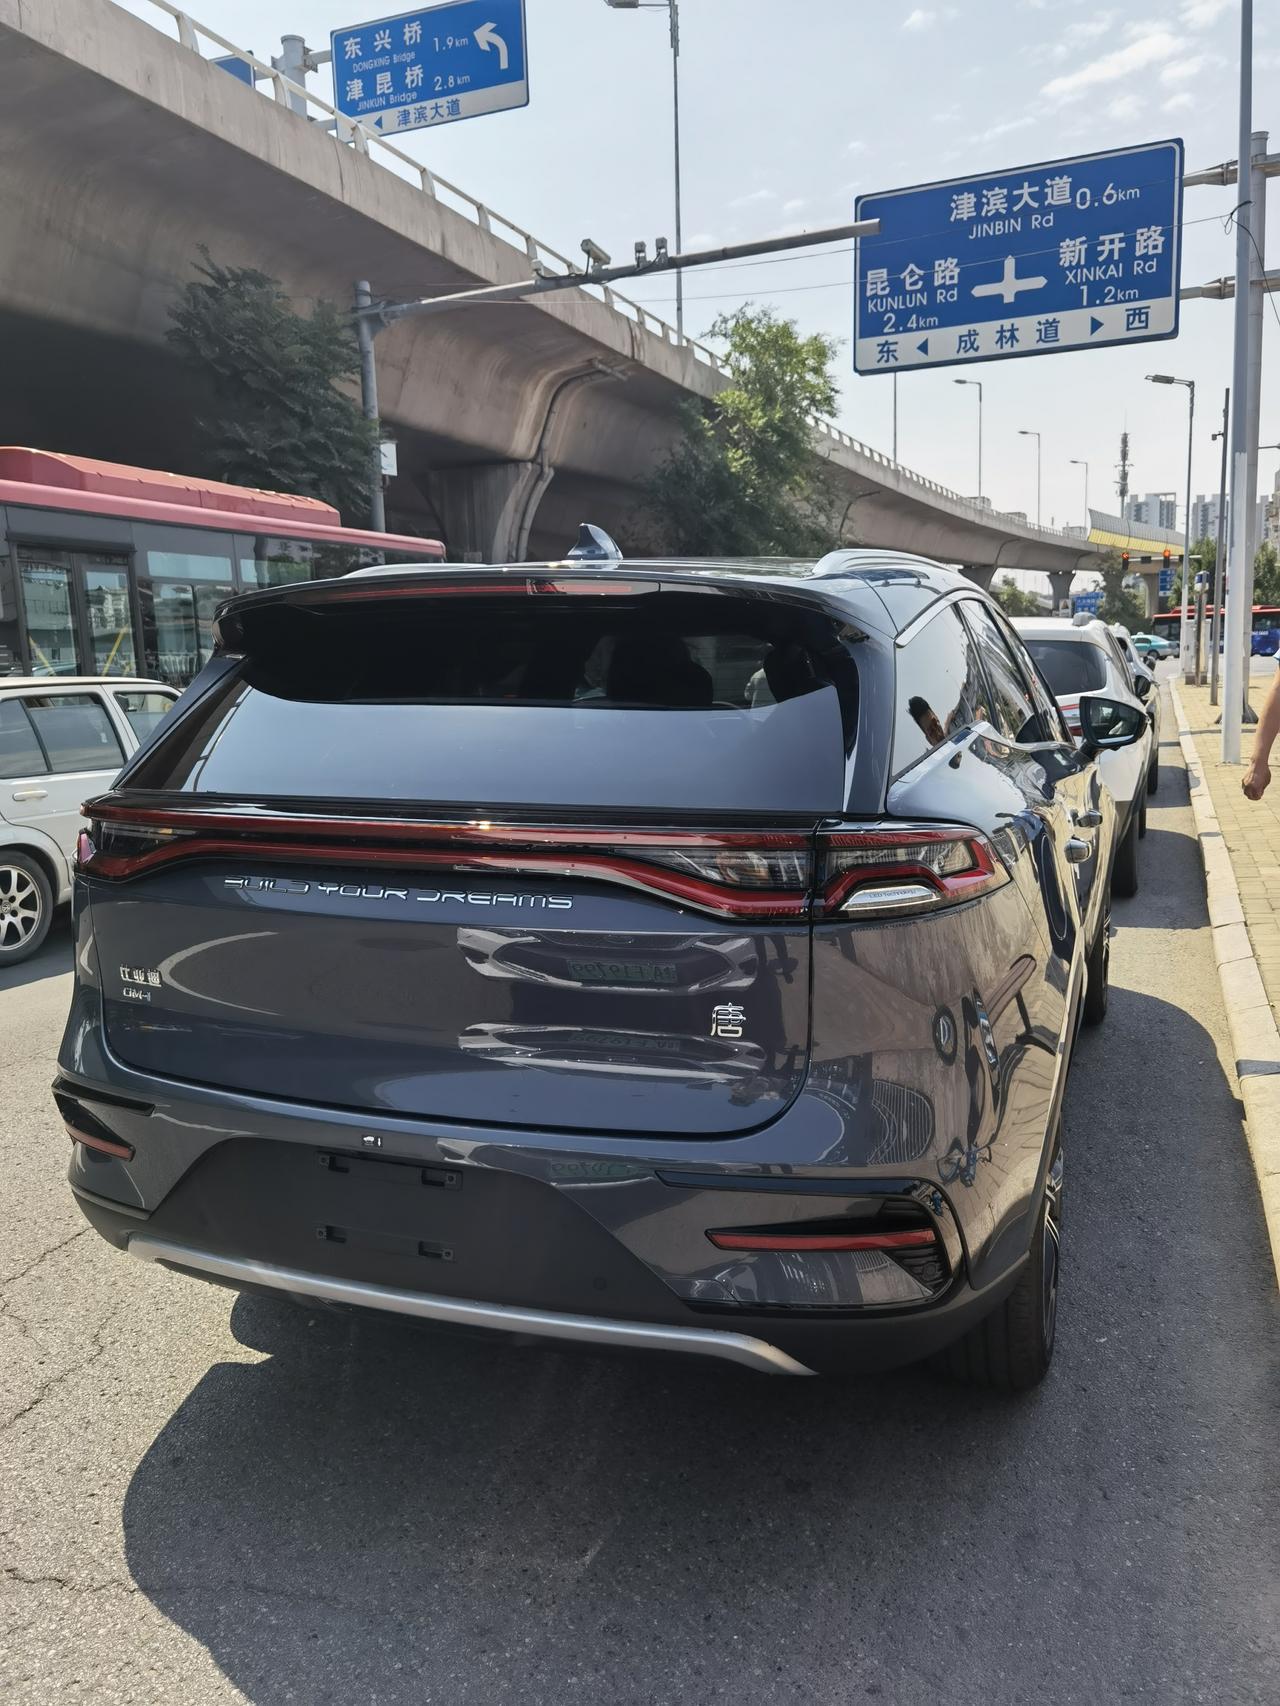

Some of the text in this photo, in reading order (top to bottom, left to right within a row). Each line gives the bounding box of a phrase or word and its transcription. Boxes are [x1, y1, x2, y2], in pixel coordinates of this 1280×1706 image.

[344, 21, 422, 60] 东兴桥
[352, 51, 416, 73] DONGXING Bridge
[346, 64, 424, 102] 津昆桥
[357, 91, 418, 111] JINKUN Bridge
[396, 98, 462, 128] 津滨大道
[950, 175, 1072, 222] 津滨大道
[968, 212, 1054, 240] JINBIN Rd
[1058, 225, 1166, 268] 新开路
[865, 257, 960, 297] 昆仑路
[1065, 258, 1157, 286] XINKAI Rd
[868, 286, 958, 313] KUNLUN Rd
[876, 306, 1150, 364] 东 成林道 西
[224, 876, 574, 910] BUILD YOUR DREAMS
[710, 1002, 746, 1038] 唐
